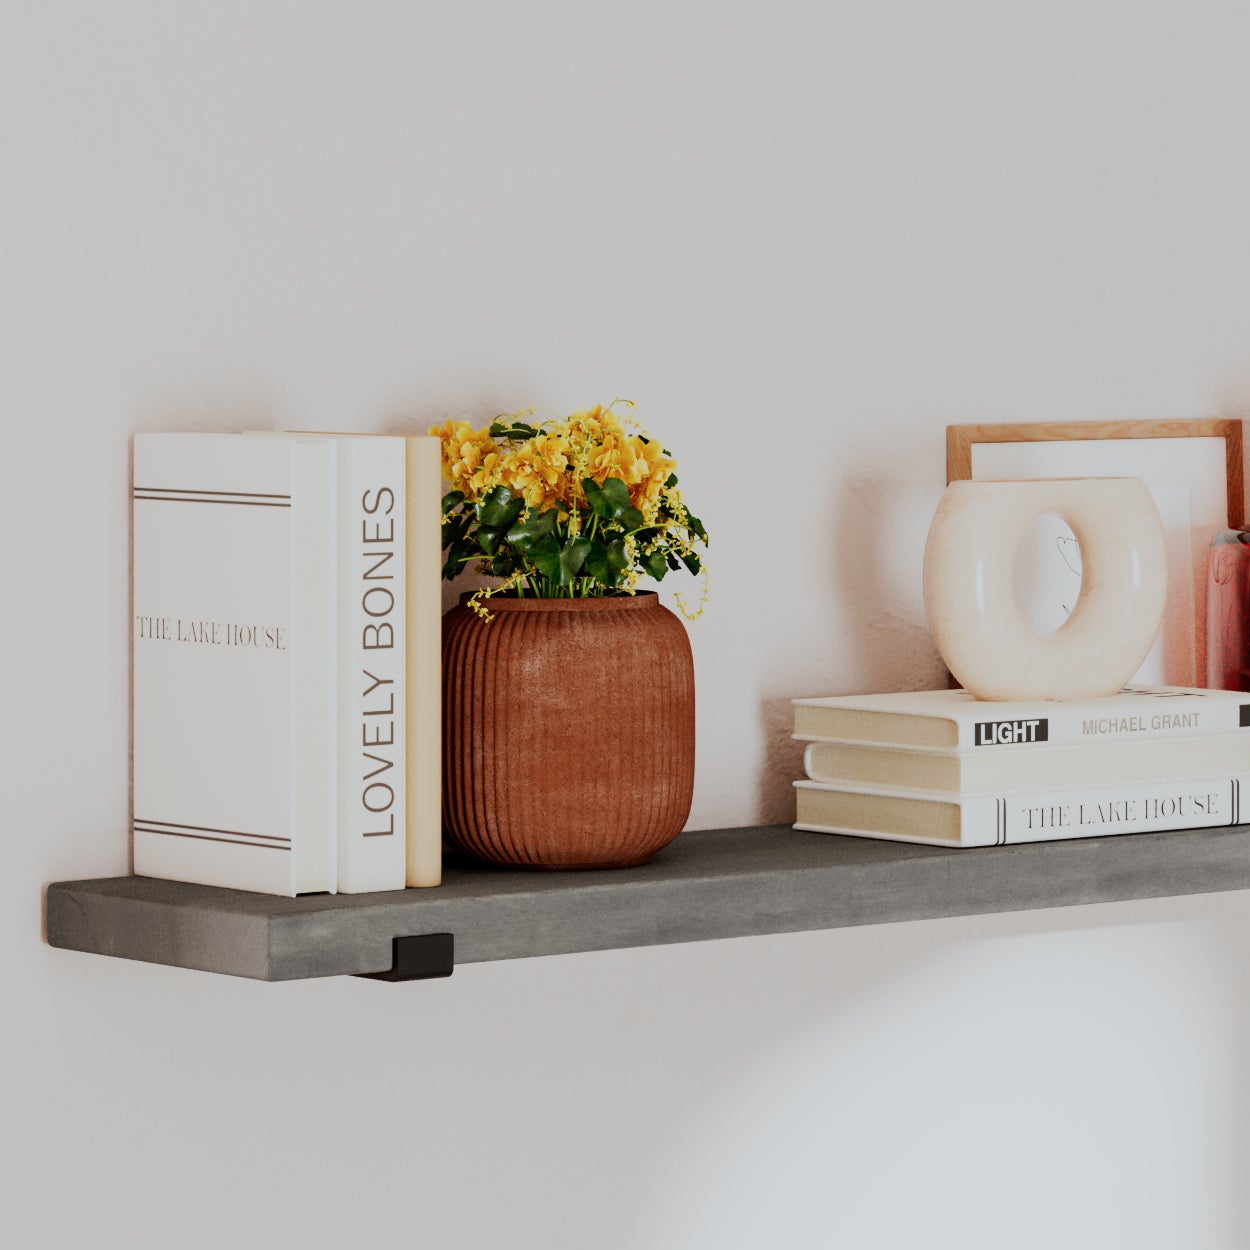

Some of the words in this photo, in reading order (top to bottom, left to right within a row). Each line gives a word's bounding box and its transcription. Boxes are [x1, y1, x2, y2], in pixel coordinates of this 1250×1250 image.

[361, 486, 395, 650] BONES
[136, 615, 172, 640] THE
[177, 619, 221, 645] LAKE
[226, 623, 286, 650] HOUSE
[979, 720, 1040, 745] LIGHT
[1082, 716, 1147, 735] MICHAEL
[1151, 712, 1200, 730] GRANT
[361, 668, 395, 838] LOVELY
[1022, 805, 1071, 829] THE
[1079, 800, 1137, 825] LAKE
[1144, 793, 1219, 820] HOUSE
